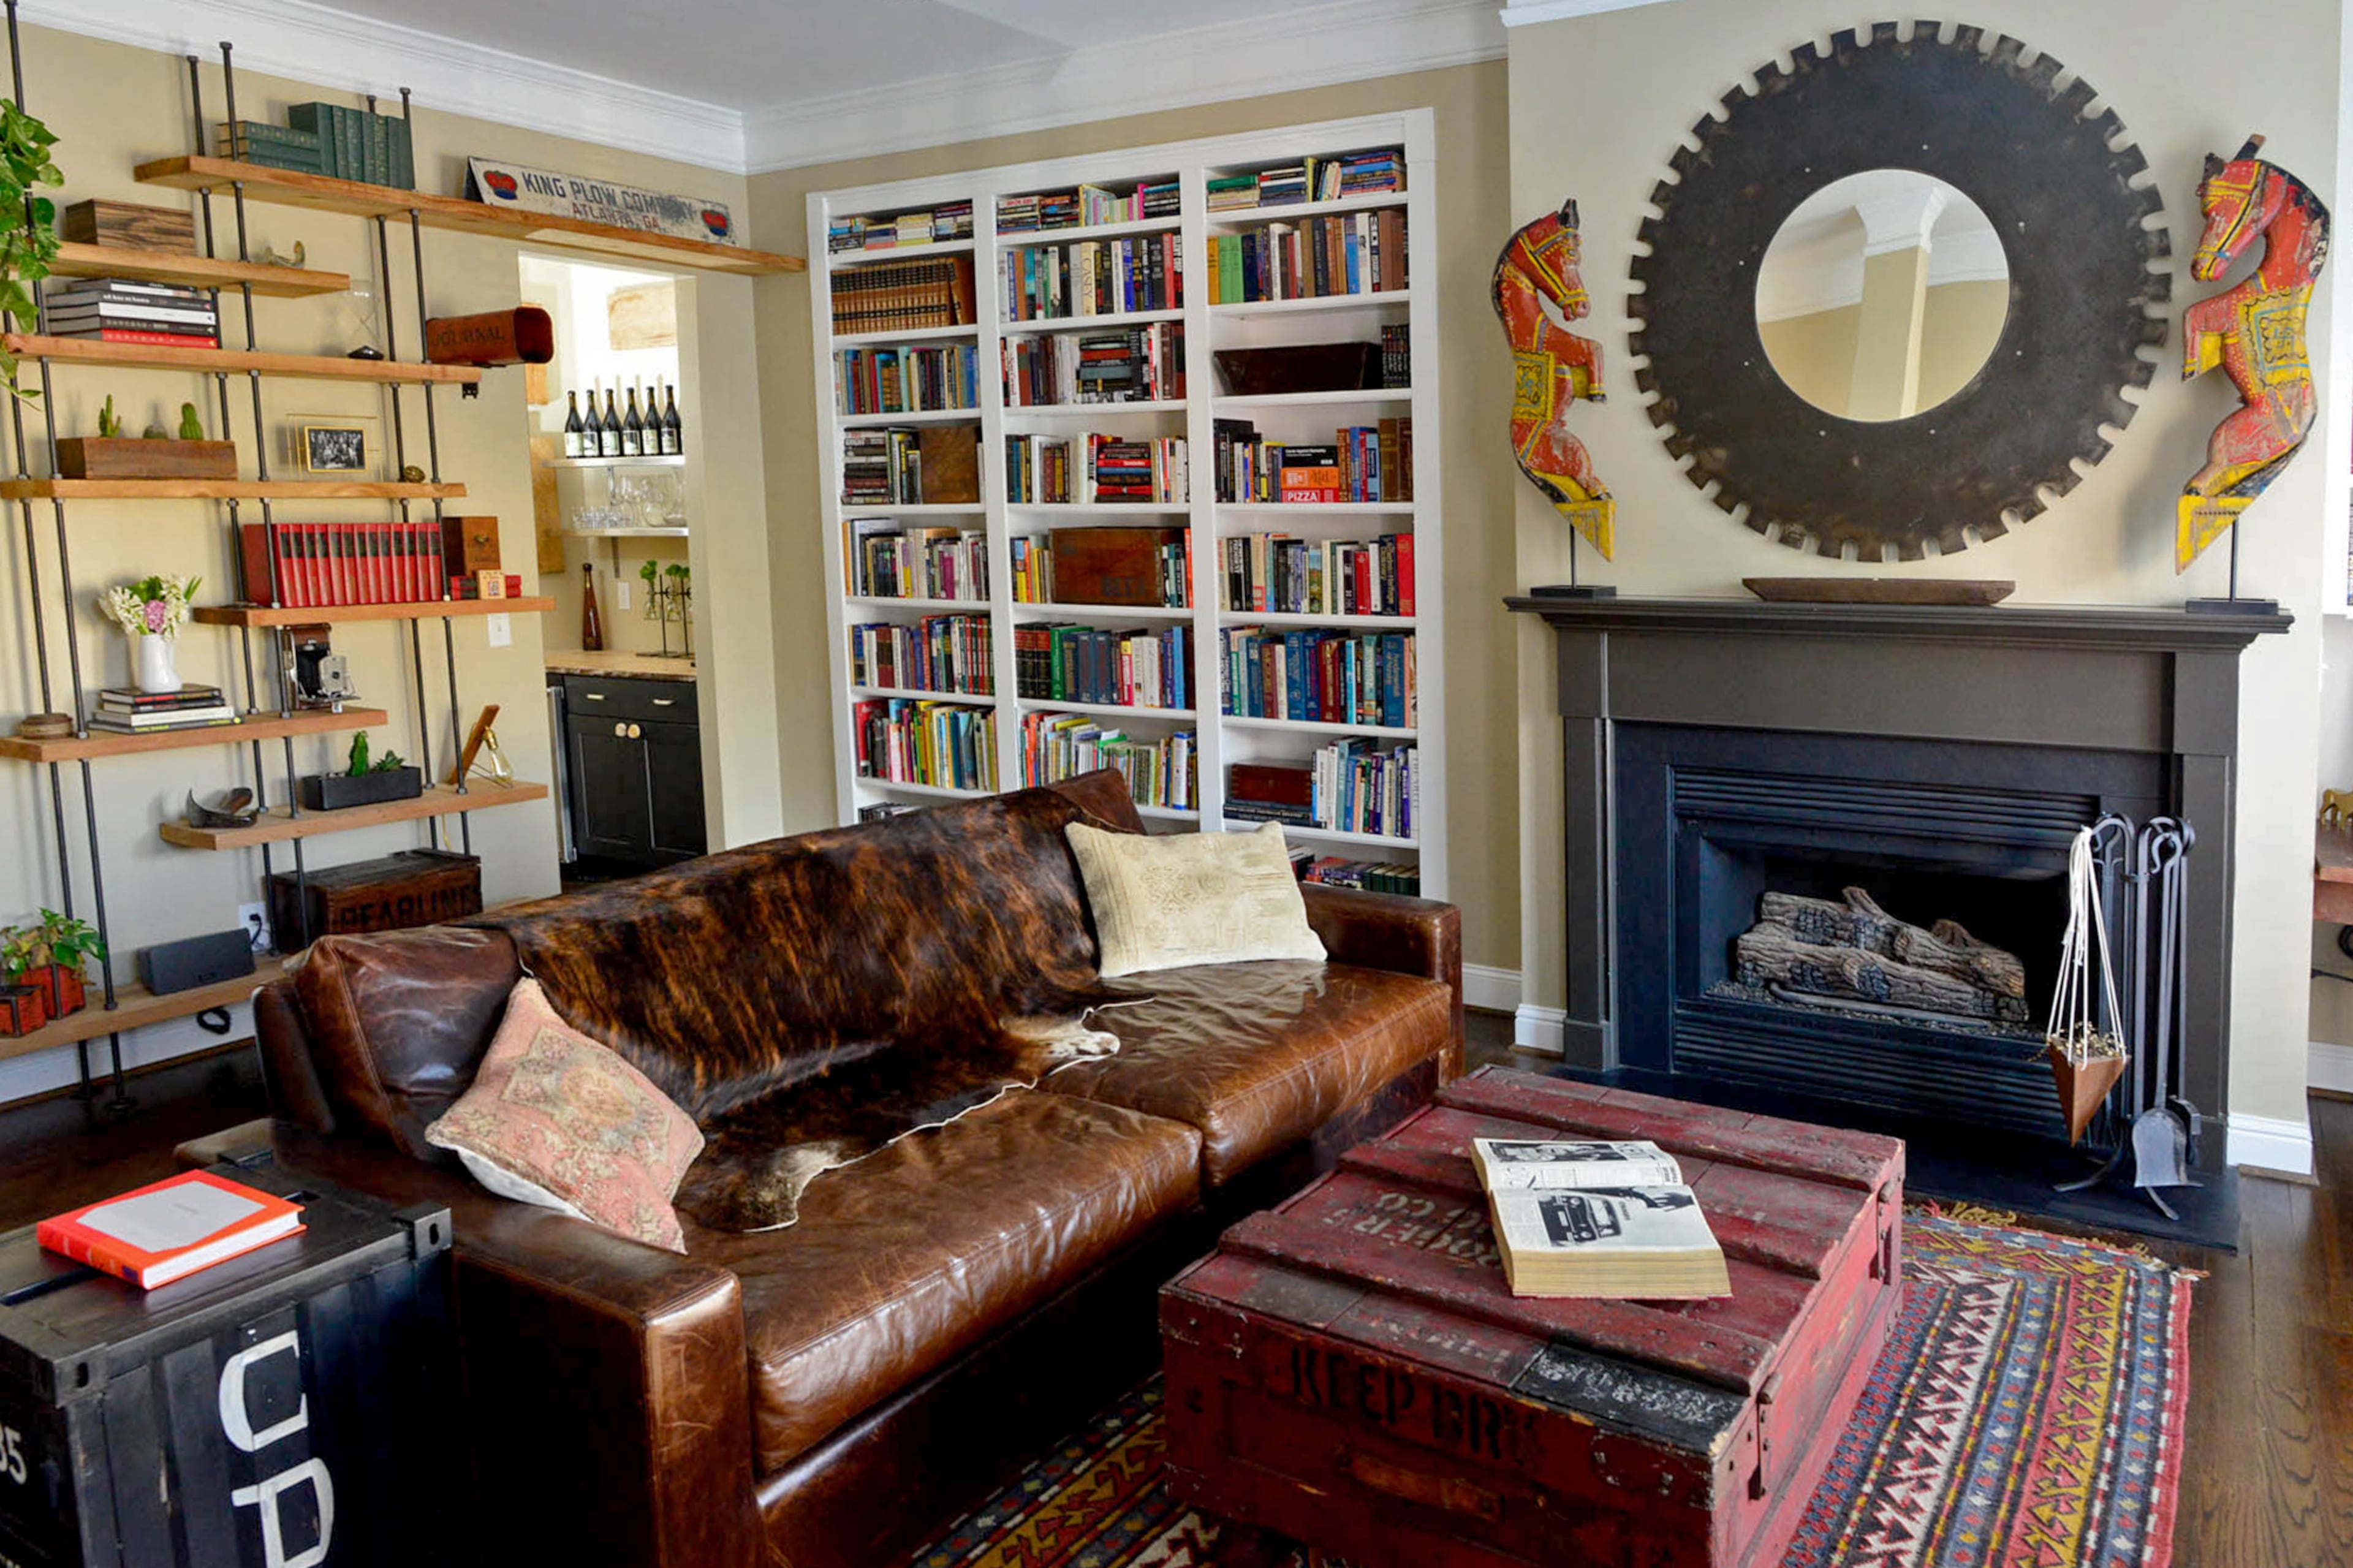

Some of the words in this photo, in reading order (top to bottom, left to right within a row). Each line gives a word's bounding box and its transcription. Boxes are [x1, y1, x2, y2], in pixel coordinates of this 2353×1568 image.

[521, 172, 566, 198] KING
[570, 180, 618, 207] PLOW
[621, 190, 694, 221] COMY
[1287, 491, 1317, 501] PIZZA
[1290, 1346, 1415, 1426] KEEP
